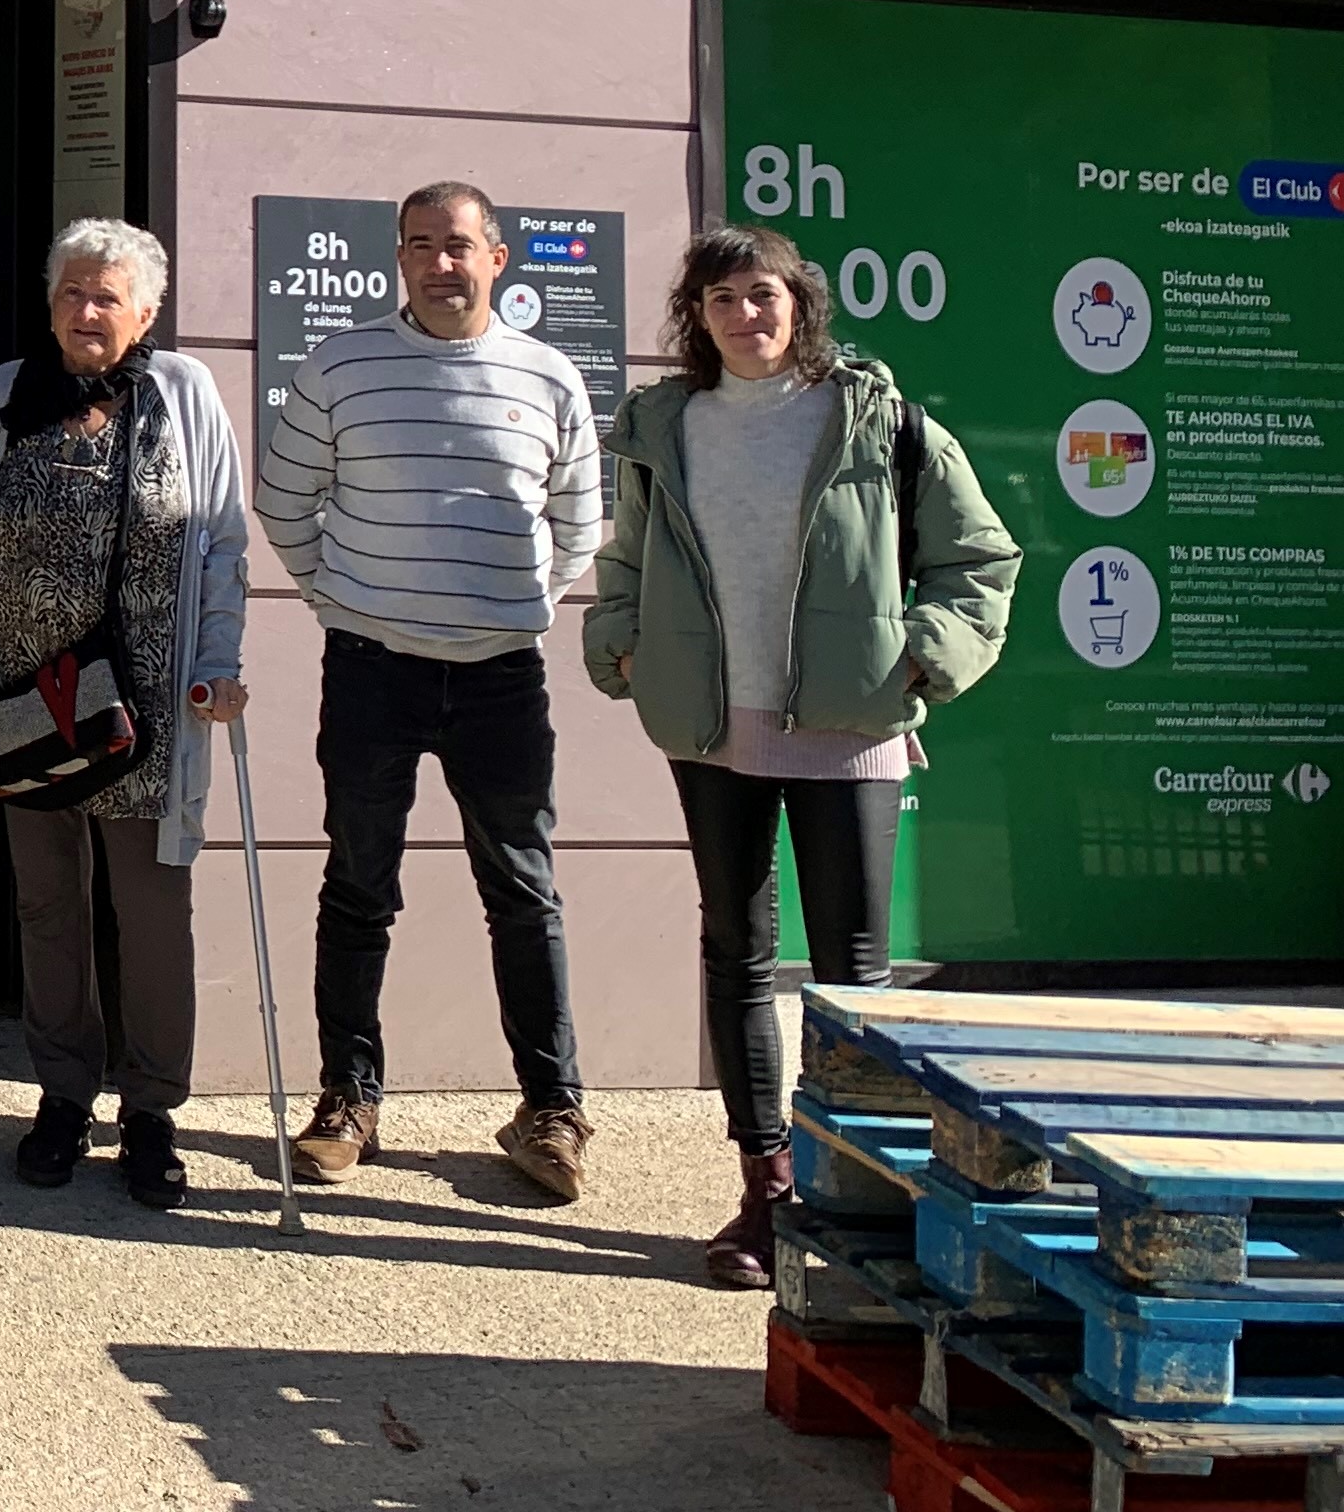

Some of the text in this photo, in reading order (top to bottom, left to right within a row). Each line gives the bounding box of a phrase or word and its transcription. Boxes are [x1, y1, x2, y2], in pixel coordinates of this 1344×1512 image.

[743, 144, 846, 219] 8h
[1078, 162, 1322, 201] Por ser de El Club
[520, 217, 596, 233] Por ser de
[1161, 218, 1291, 240] -ekoa izateagatik
[307, 232, 348, 261] 8h
[534, 243, 568, 254] El Club
[269, 268, 388, 299] a 21h00
[1162, 270, 1263, 289] Disfruta de tu
[1162, 288, 1271, 307] ChequeAhorro
[304, 302, 352, 314] de lunes
[303, 316, 354, 327] a sábado
[1166, 410, 1315, 429] TE AHORRAS EL IVA
[1167, 429, 1325, 447] en productos frescos.
[1169, 545, 1325, 563] 1% DE TUS COMPRAS
[1088, 561, 1129, 606] 1%
[1105, 700, 1146, 713] Conoce
[1154, 765, 1274, 793] Carrefour
[1207, 797, 1272, 817] express
